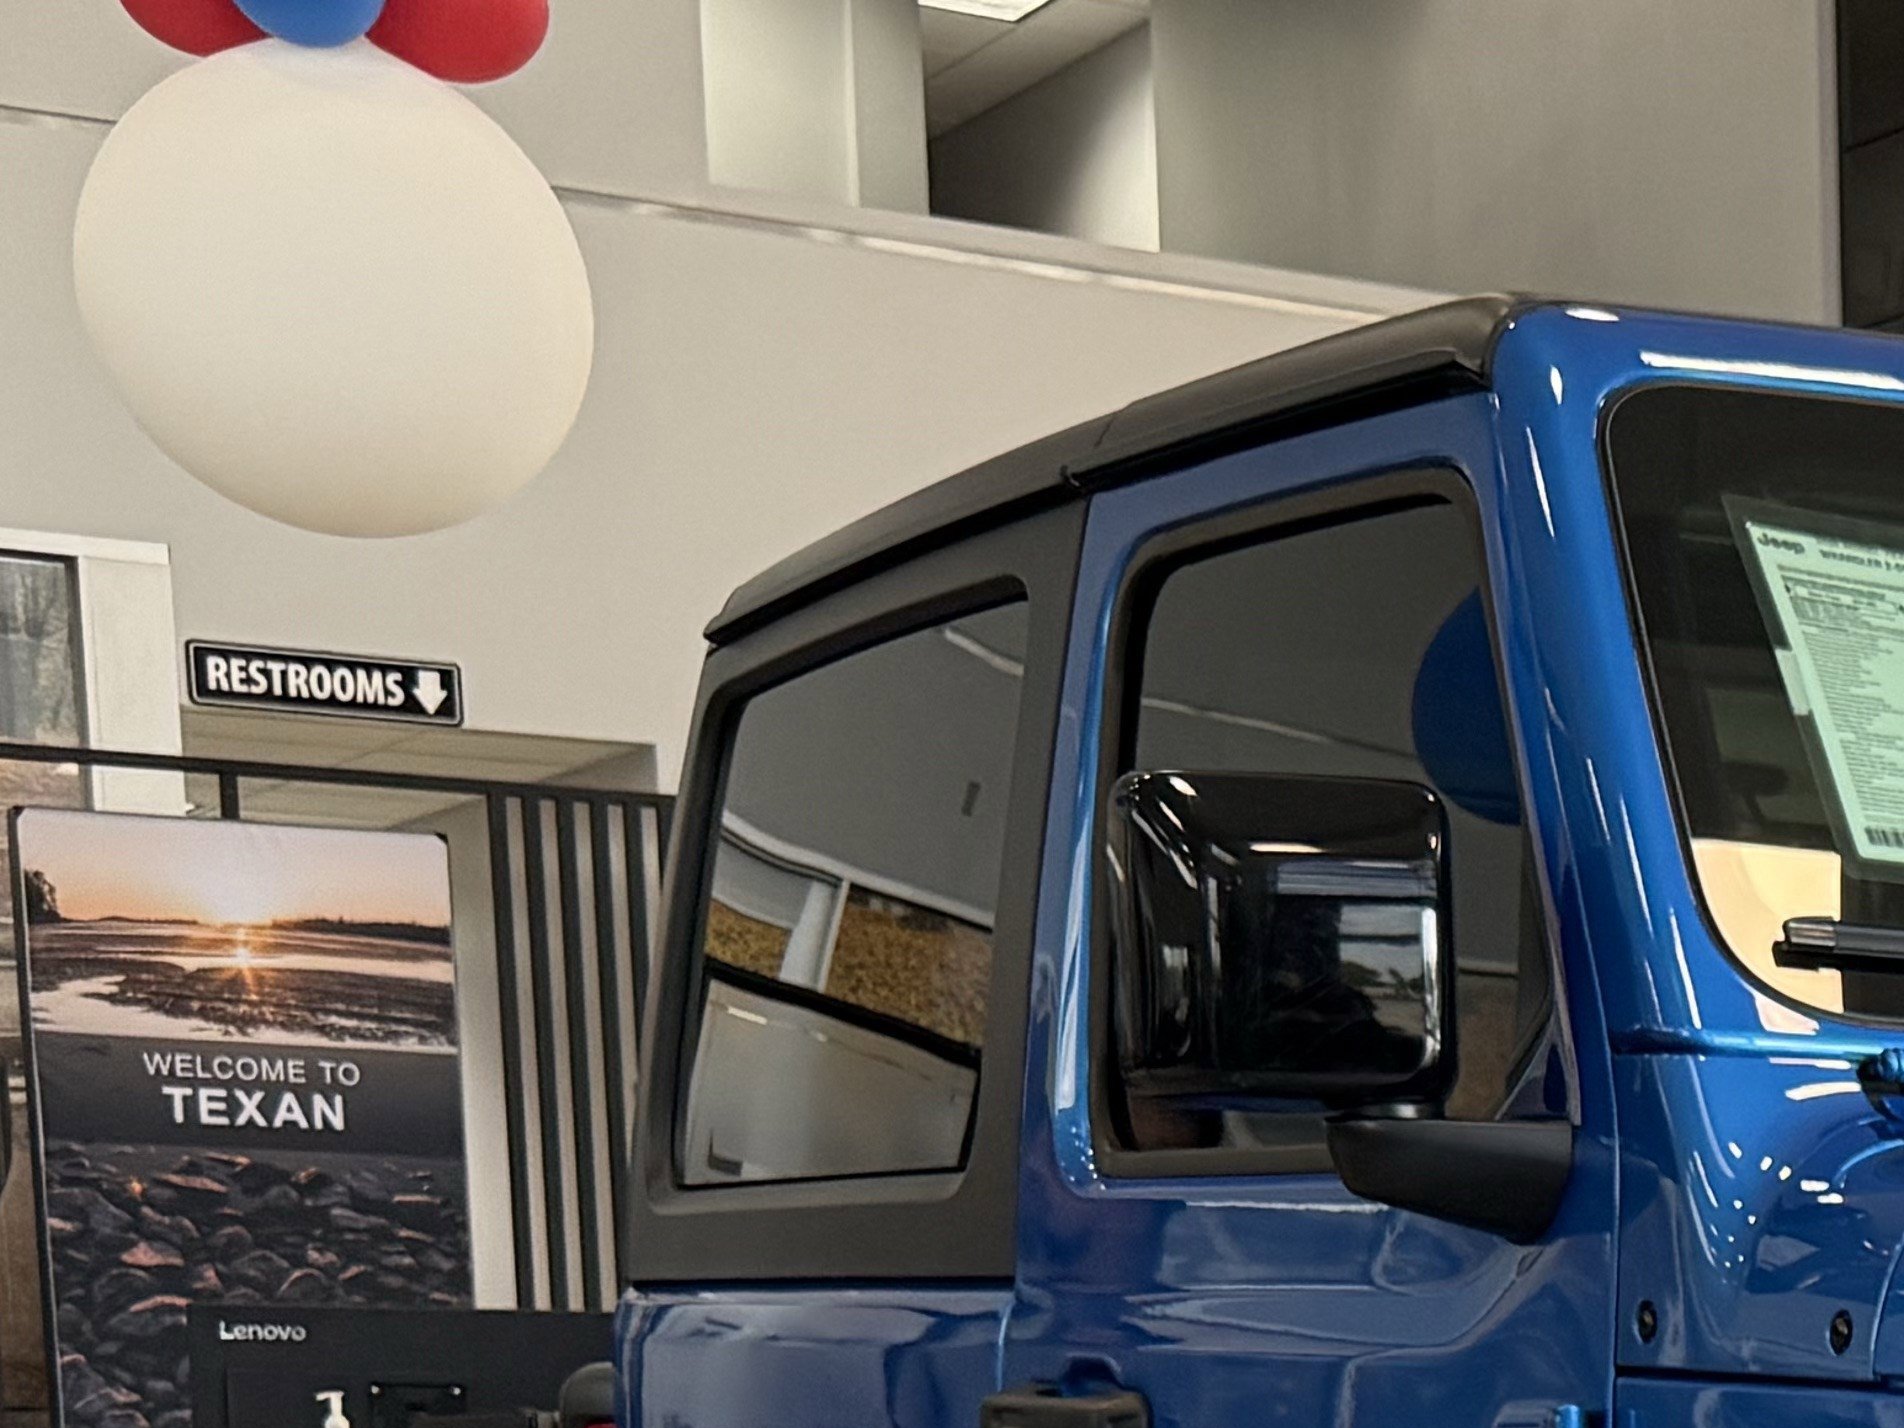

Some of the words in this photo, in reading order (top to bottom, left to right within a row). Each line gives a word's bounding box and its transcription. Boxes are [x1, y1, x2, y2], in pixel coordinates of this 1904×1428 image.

[1757, 532, 1805, 555] Jeep
[205, 654, 406, 708] RESTROOMS
[141, 1050, 308, 1087] WELCOME
[319, 1059, 361, 1089] TO
[161, 1085, 346, 1132] TEXAN
[218, 1318, 307, 1344] Lenovo
